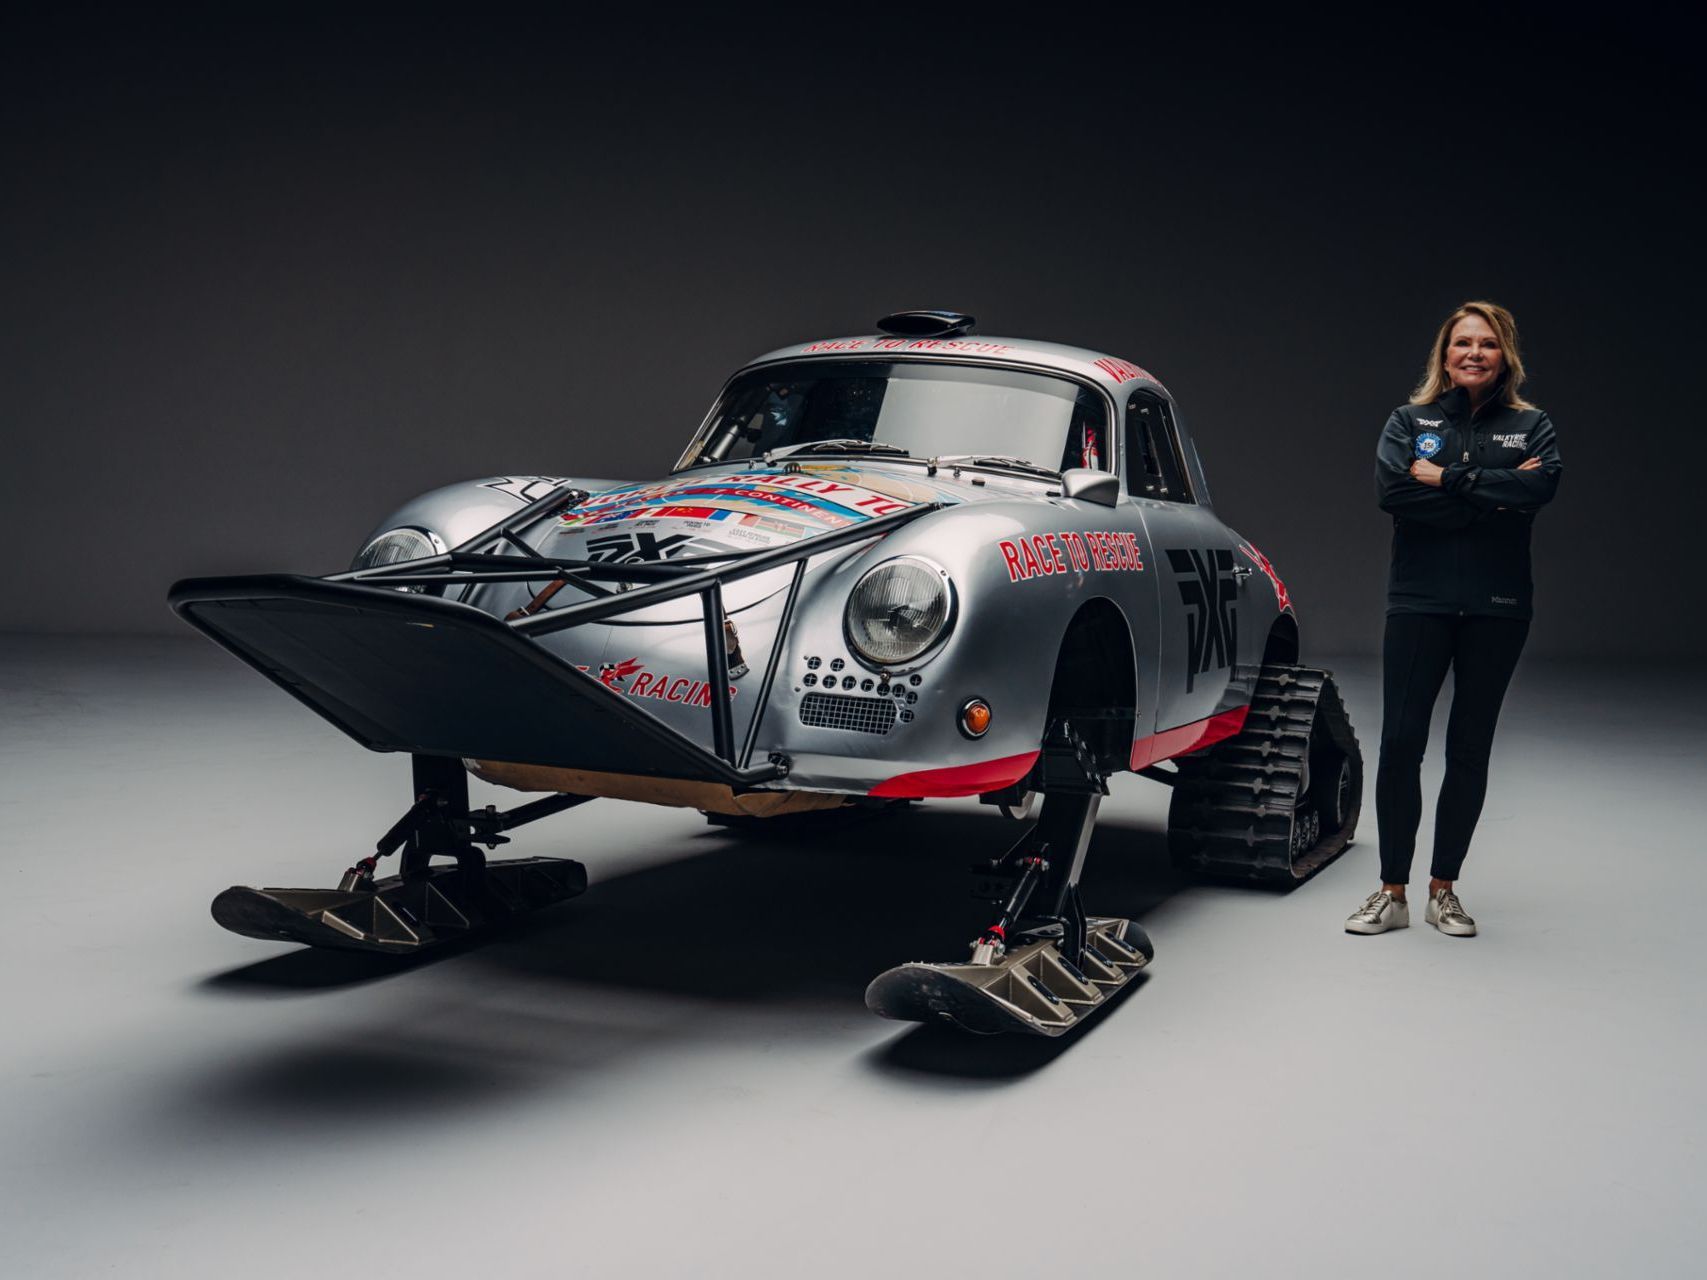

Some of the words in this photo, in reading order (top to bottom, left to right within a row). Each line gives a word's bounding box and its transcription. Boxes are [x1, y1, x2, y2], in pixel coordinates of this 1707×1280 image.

[801, 340, 867, 352] RACE
[873, 338, 906, 349] TO
[908, 339, 1013, 354] RESCUE
[1492, 433, 1527, 442] VALKYRIE
[1502, 440, 1527, 450] RACING
[719, 475, 855, 494] RALLY
[734, 489, 855, 526] CONTINEN
[1000, 533, 1066, 583] RACE
[1060, 531, 1089, 572] TO
[1084, 531, 1144, 571] RESCUE
